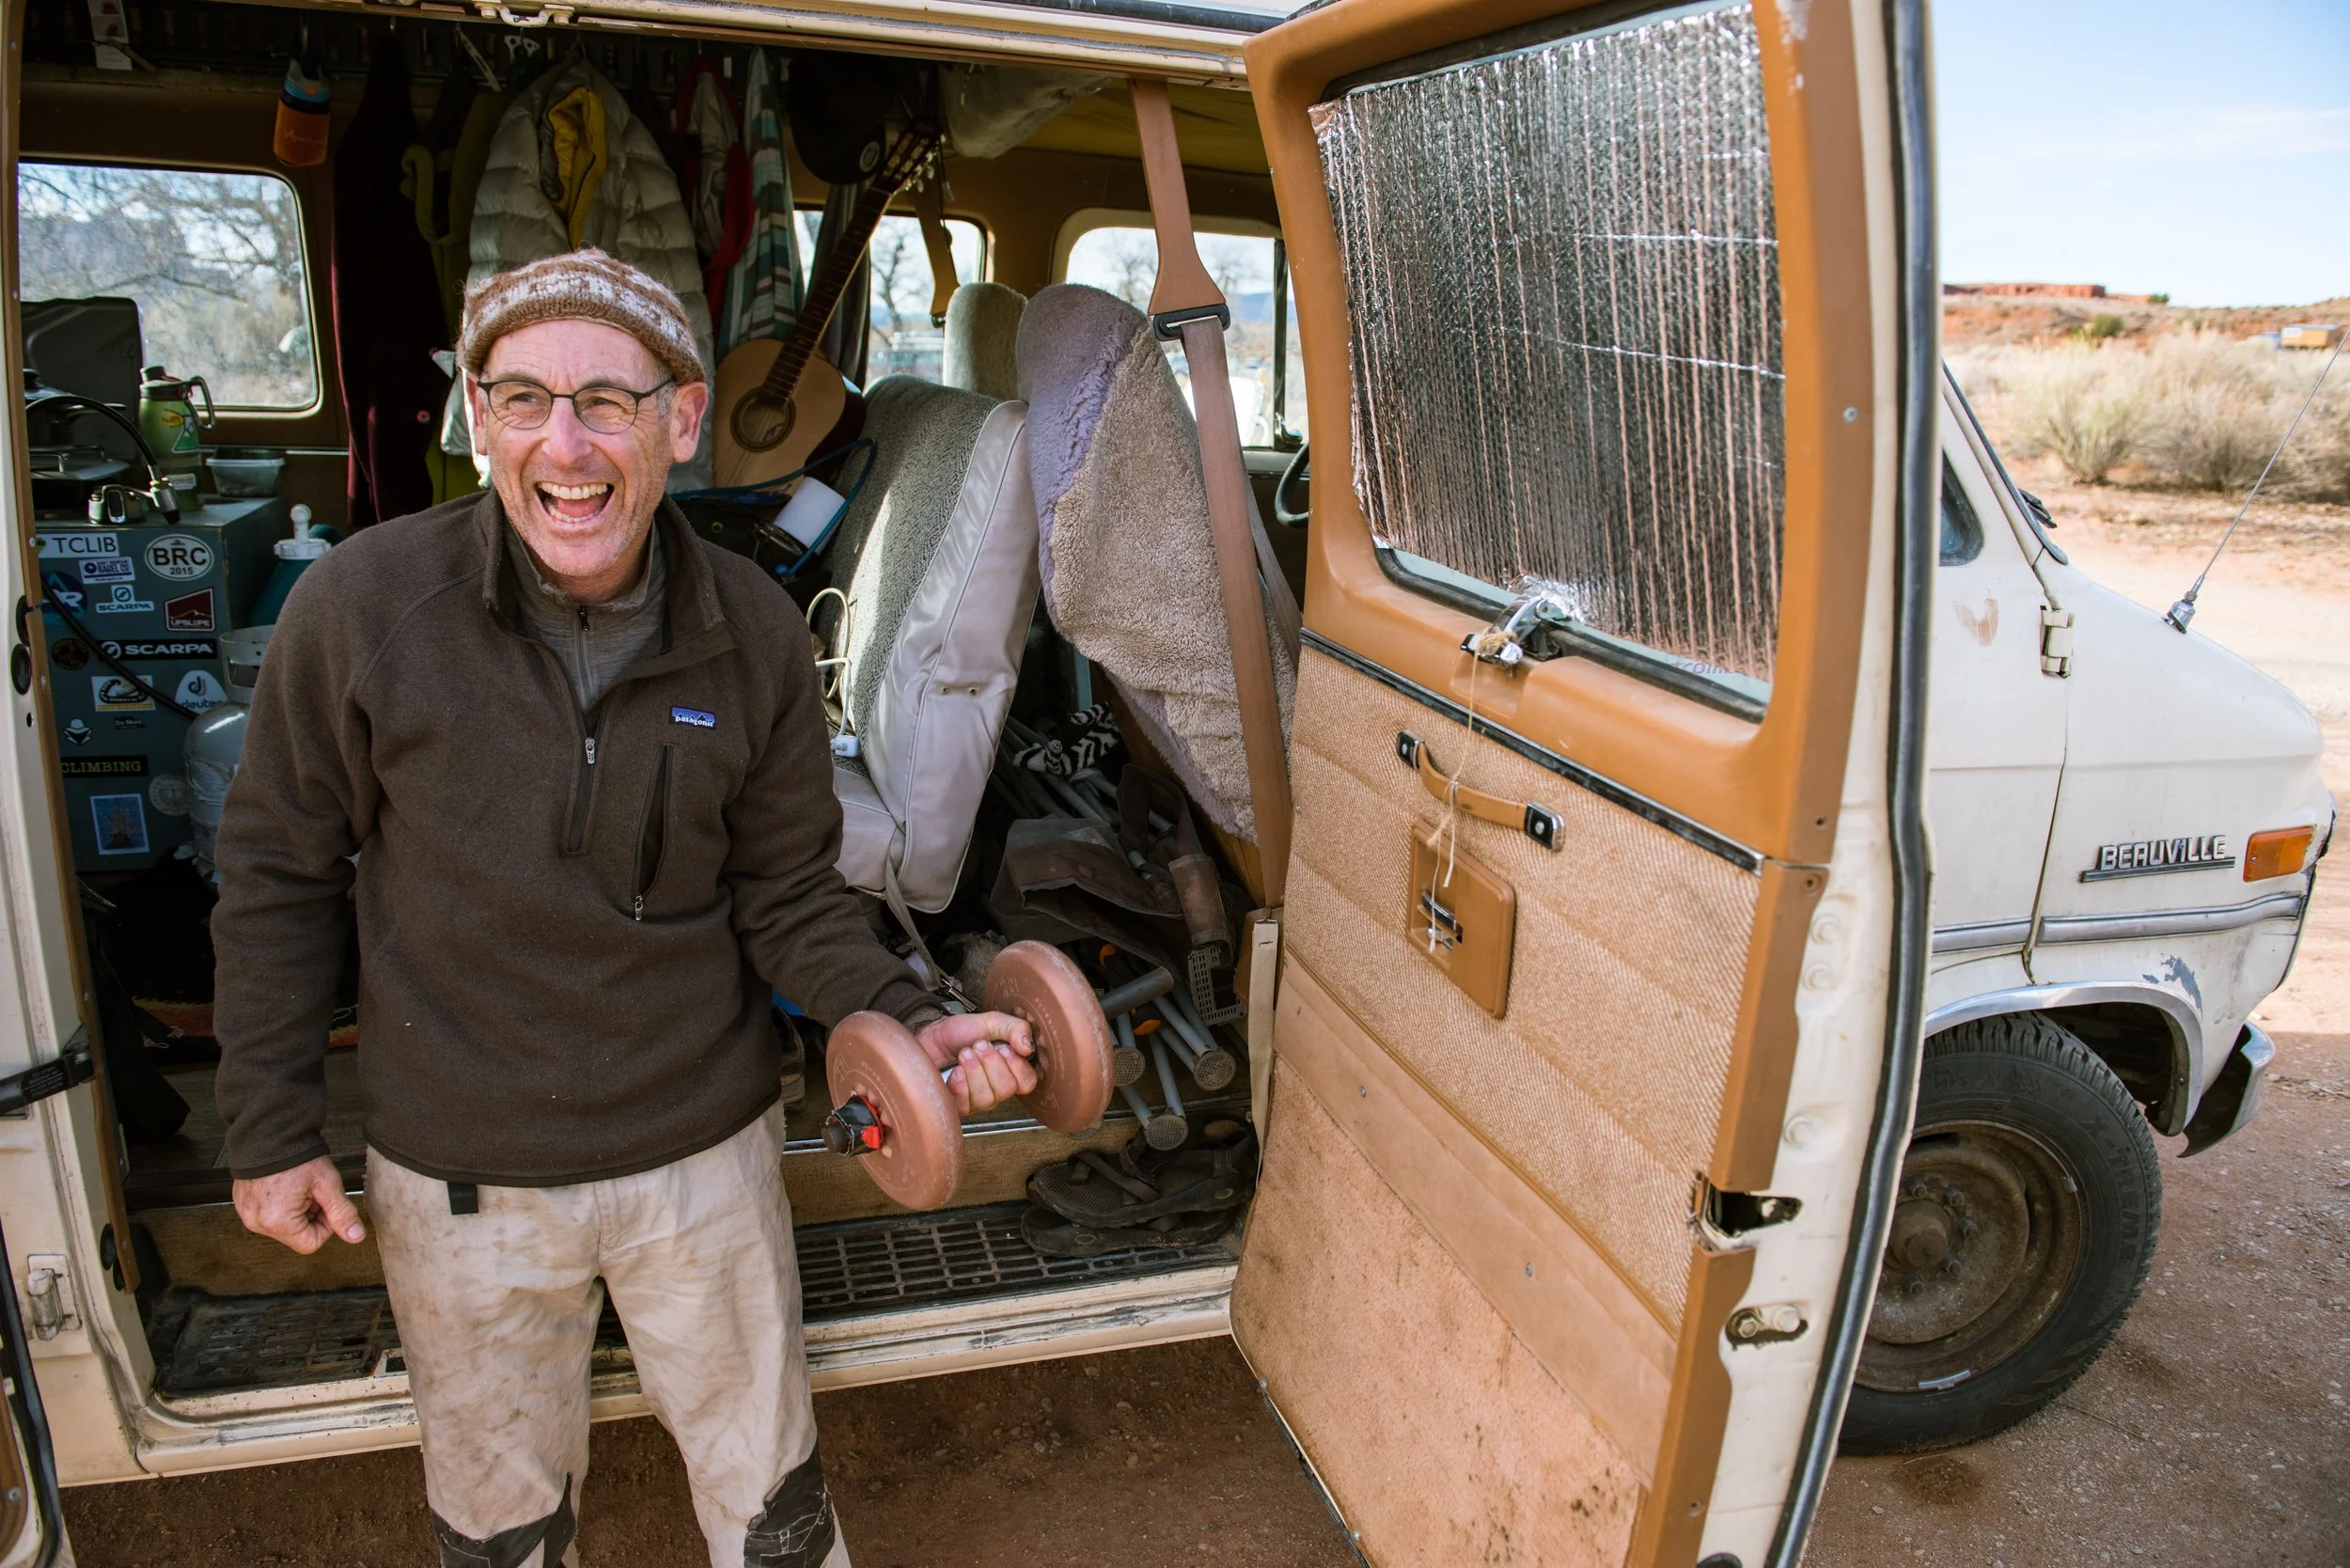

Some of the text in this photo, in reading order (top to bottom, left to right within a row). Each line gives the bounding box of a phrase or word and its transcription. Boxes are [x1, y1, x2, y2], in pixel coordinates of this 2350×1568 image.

[52, 537, 117, 553] TCLIB
[152, 546, 207, 566] BRC
[169, 567, 194, 575] 2015
[98, 603, 152, 611] SCARPA
[170, 619, 212, 627] UPSLOPE
[125, 643, 214, 655] SCARPA
[675, 714, 713, 728] patagonia
[59, 760, 144, 774] CLIMBING
[2098, 835, 2227, 871] BEAUVILLE
